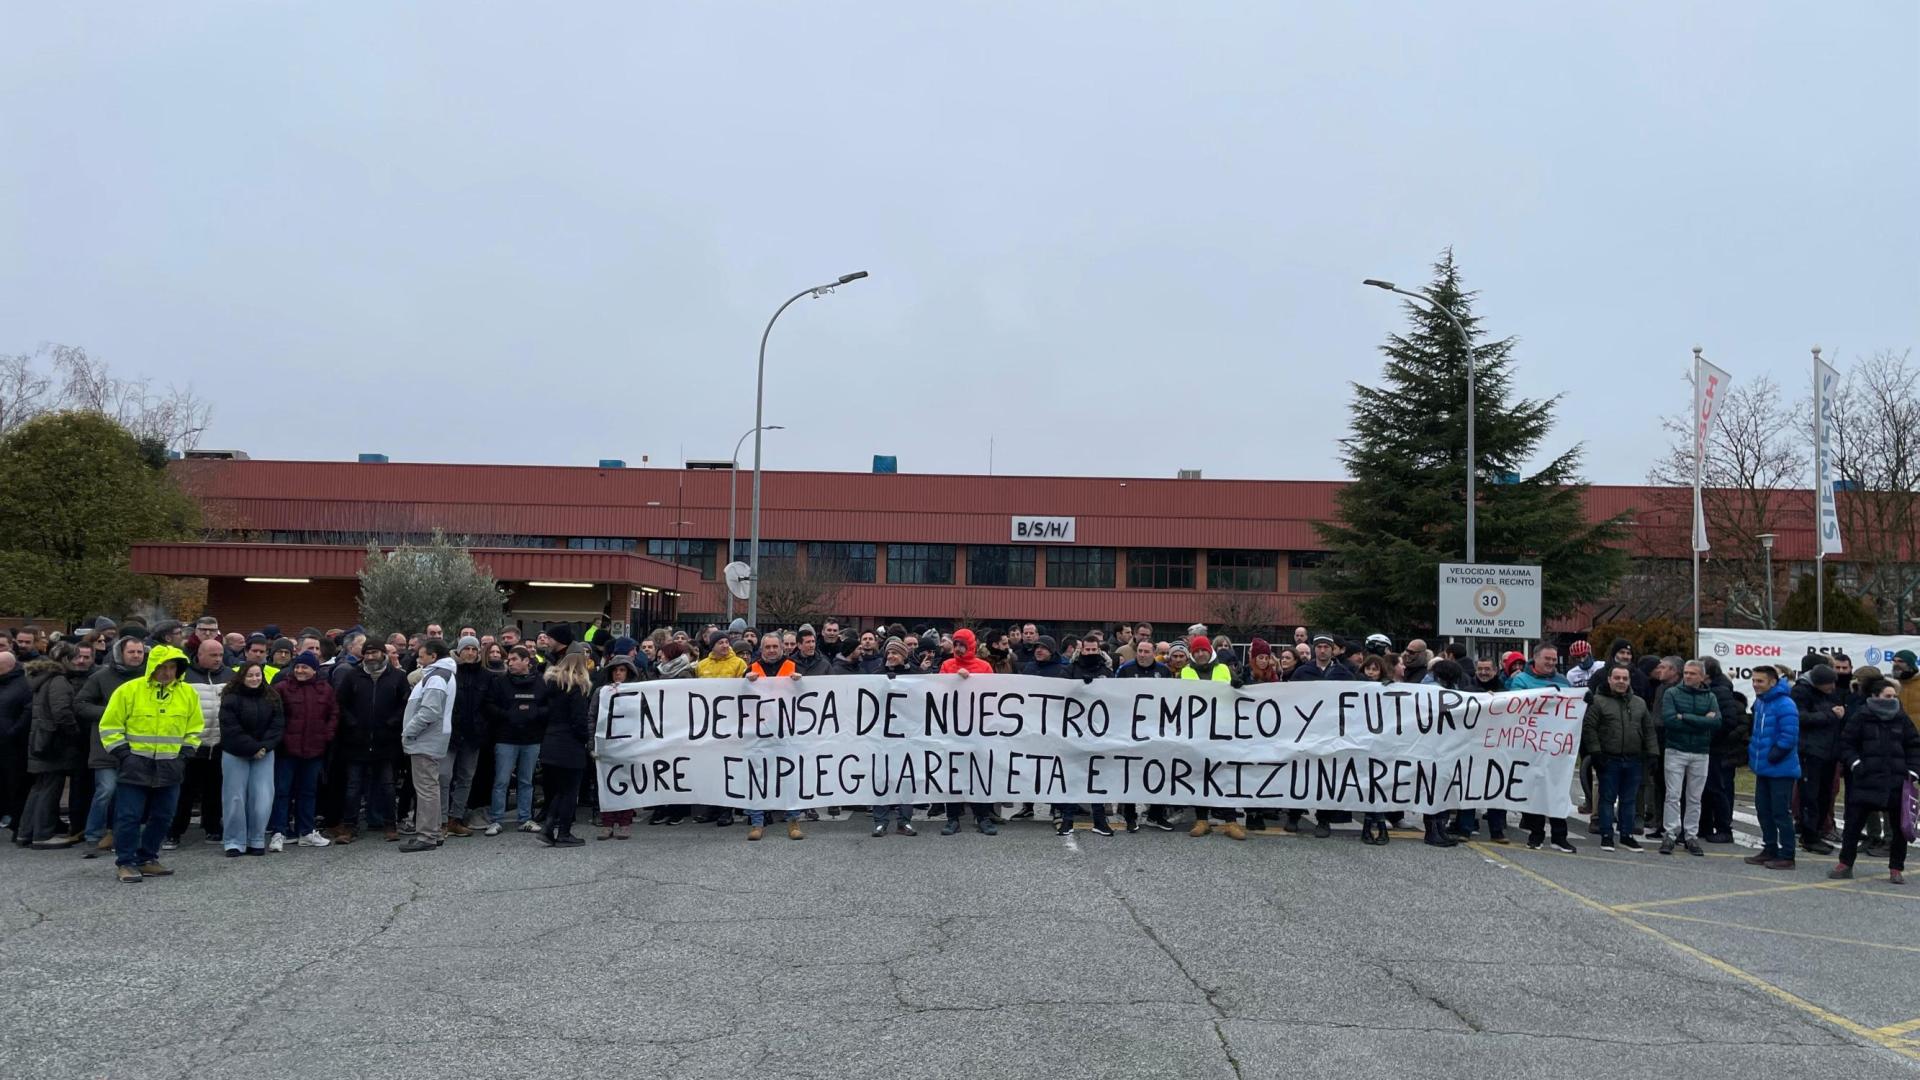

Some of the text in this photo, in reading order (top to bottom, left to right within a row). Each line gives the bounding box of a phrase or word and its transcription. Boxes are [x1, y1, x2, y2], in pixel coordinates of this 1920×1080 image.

[1017, 521, 1069, 538] B/S/H/
[1450, 567, 1531, 577] VELOCIDAD MÁXIMA
[1461, 577, 1483, 585] TODO
[1499, 578, 1535, 586] RECINTO
[1482, 595, 1499, 607] 30
[1455, 618, 1525, 627] MAXIMUM SPEED
[1475, 627, 1491, 635] ALL
[1734, 644, 1781, 657] BOSCH
[605, 689, 664, 740] EN
[688, 690, 840, 741] DEFENSA
[856, 688, 908, 738] DE
[924, 689, 1110, 738] NUESTRO
[1131, 693, 1282, 742] EMPLEO
[1338, 689, 1482, 737] FUTURO
[1518, 716, 1538, 728] DE
[1483, 727, 1575, 757] EMPRESA
[606, 749, 1531, 805] GURE ENPLEGUAREN ETA ETORKIZUNAREN ALDE
